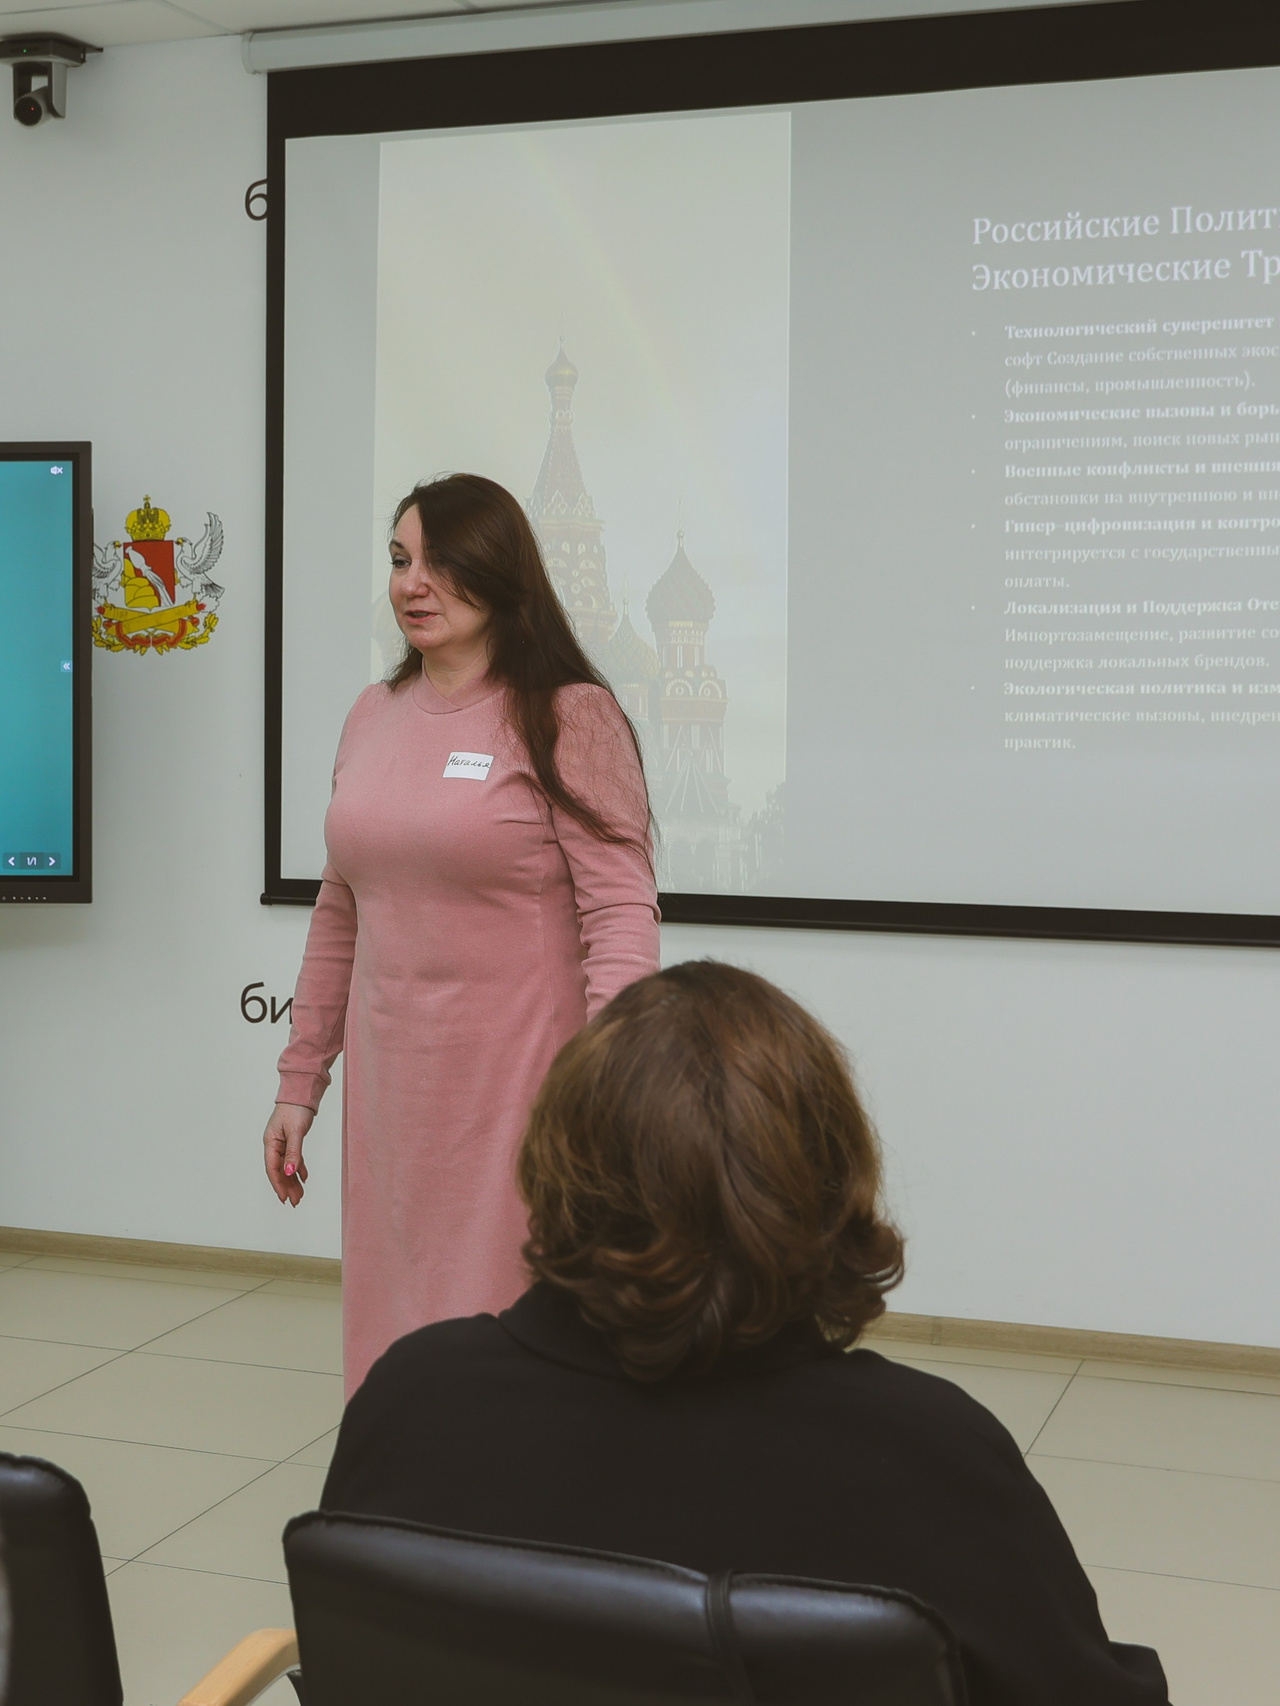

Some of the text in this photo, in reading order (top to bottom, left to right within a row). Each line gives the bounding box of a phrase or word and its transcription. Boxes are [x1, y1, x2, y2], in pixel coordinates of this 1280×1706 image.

[972, 205, 1280, 245] Российские Полит
[972, 255, 1232, 290] Экономические
[1005, 316, 1274, 339] Технологический суверенитет
[1005, 351, 1043, 370] софт
[1047, 350, 1124, 367] Создание
[1128, 346, 1237, 362] собственных
[1005, 370, 1256, 398] (финансы, промышленность).
[1005, 407, 1141, 424] Экономические
[1146, 404, 1215, 419] вызовы
[1220, 404, 1231, 416] и
[1005, 434, 1128, 453] ограничениям,
[1133, 433, 1181, 448] поиск
[1186, 432, 1240, 446] новых
[1005, 464, 1082, 479] Военные
[1086, 460, 1189, 479] конфликты
[1195, 463, 1206, 474] и
[1005, 489, 1280, 507] обстановки на внутреннюю и вн
[1201, 519, 1212, 530] и
[1005, 548, 1126, 564] интегрируется
[1131, 548, 1140, 559] с
[1004, 576, 1070, 588] оплаты.
[1004, 601, 1121, 616] Локализация
[1127, 602, 1137, 614] и
[1142, 600, 1242, 616] Поддержка
[1005, 627, 1173, 644] Импортозамещение,
[1178, 627, 1256, 643] развитие
[1005, 652, 1270, 673] поддержка локальных брендов.
[1004, 681, 1135, 697] Экологическая
[1140, 682, 1227, 695] политика
[1232, 683, 1243, 694] и
[1004, 708, 1131, 722] климатические
[1135, 709, 1205, 724] вызовы,
[1004, 736, 1076, 751] практик.
